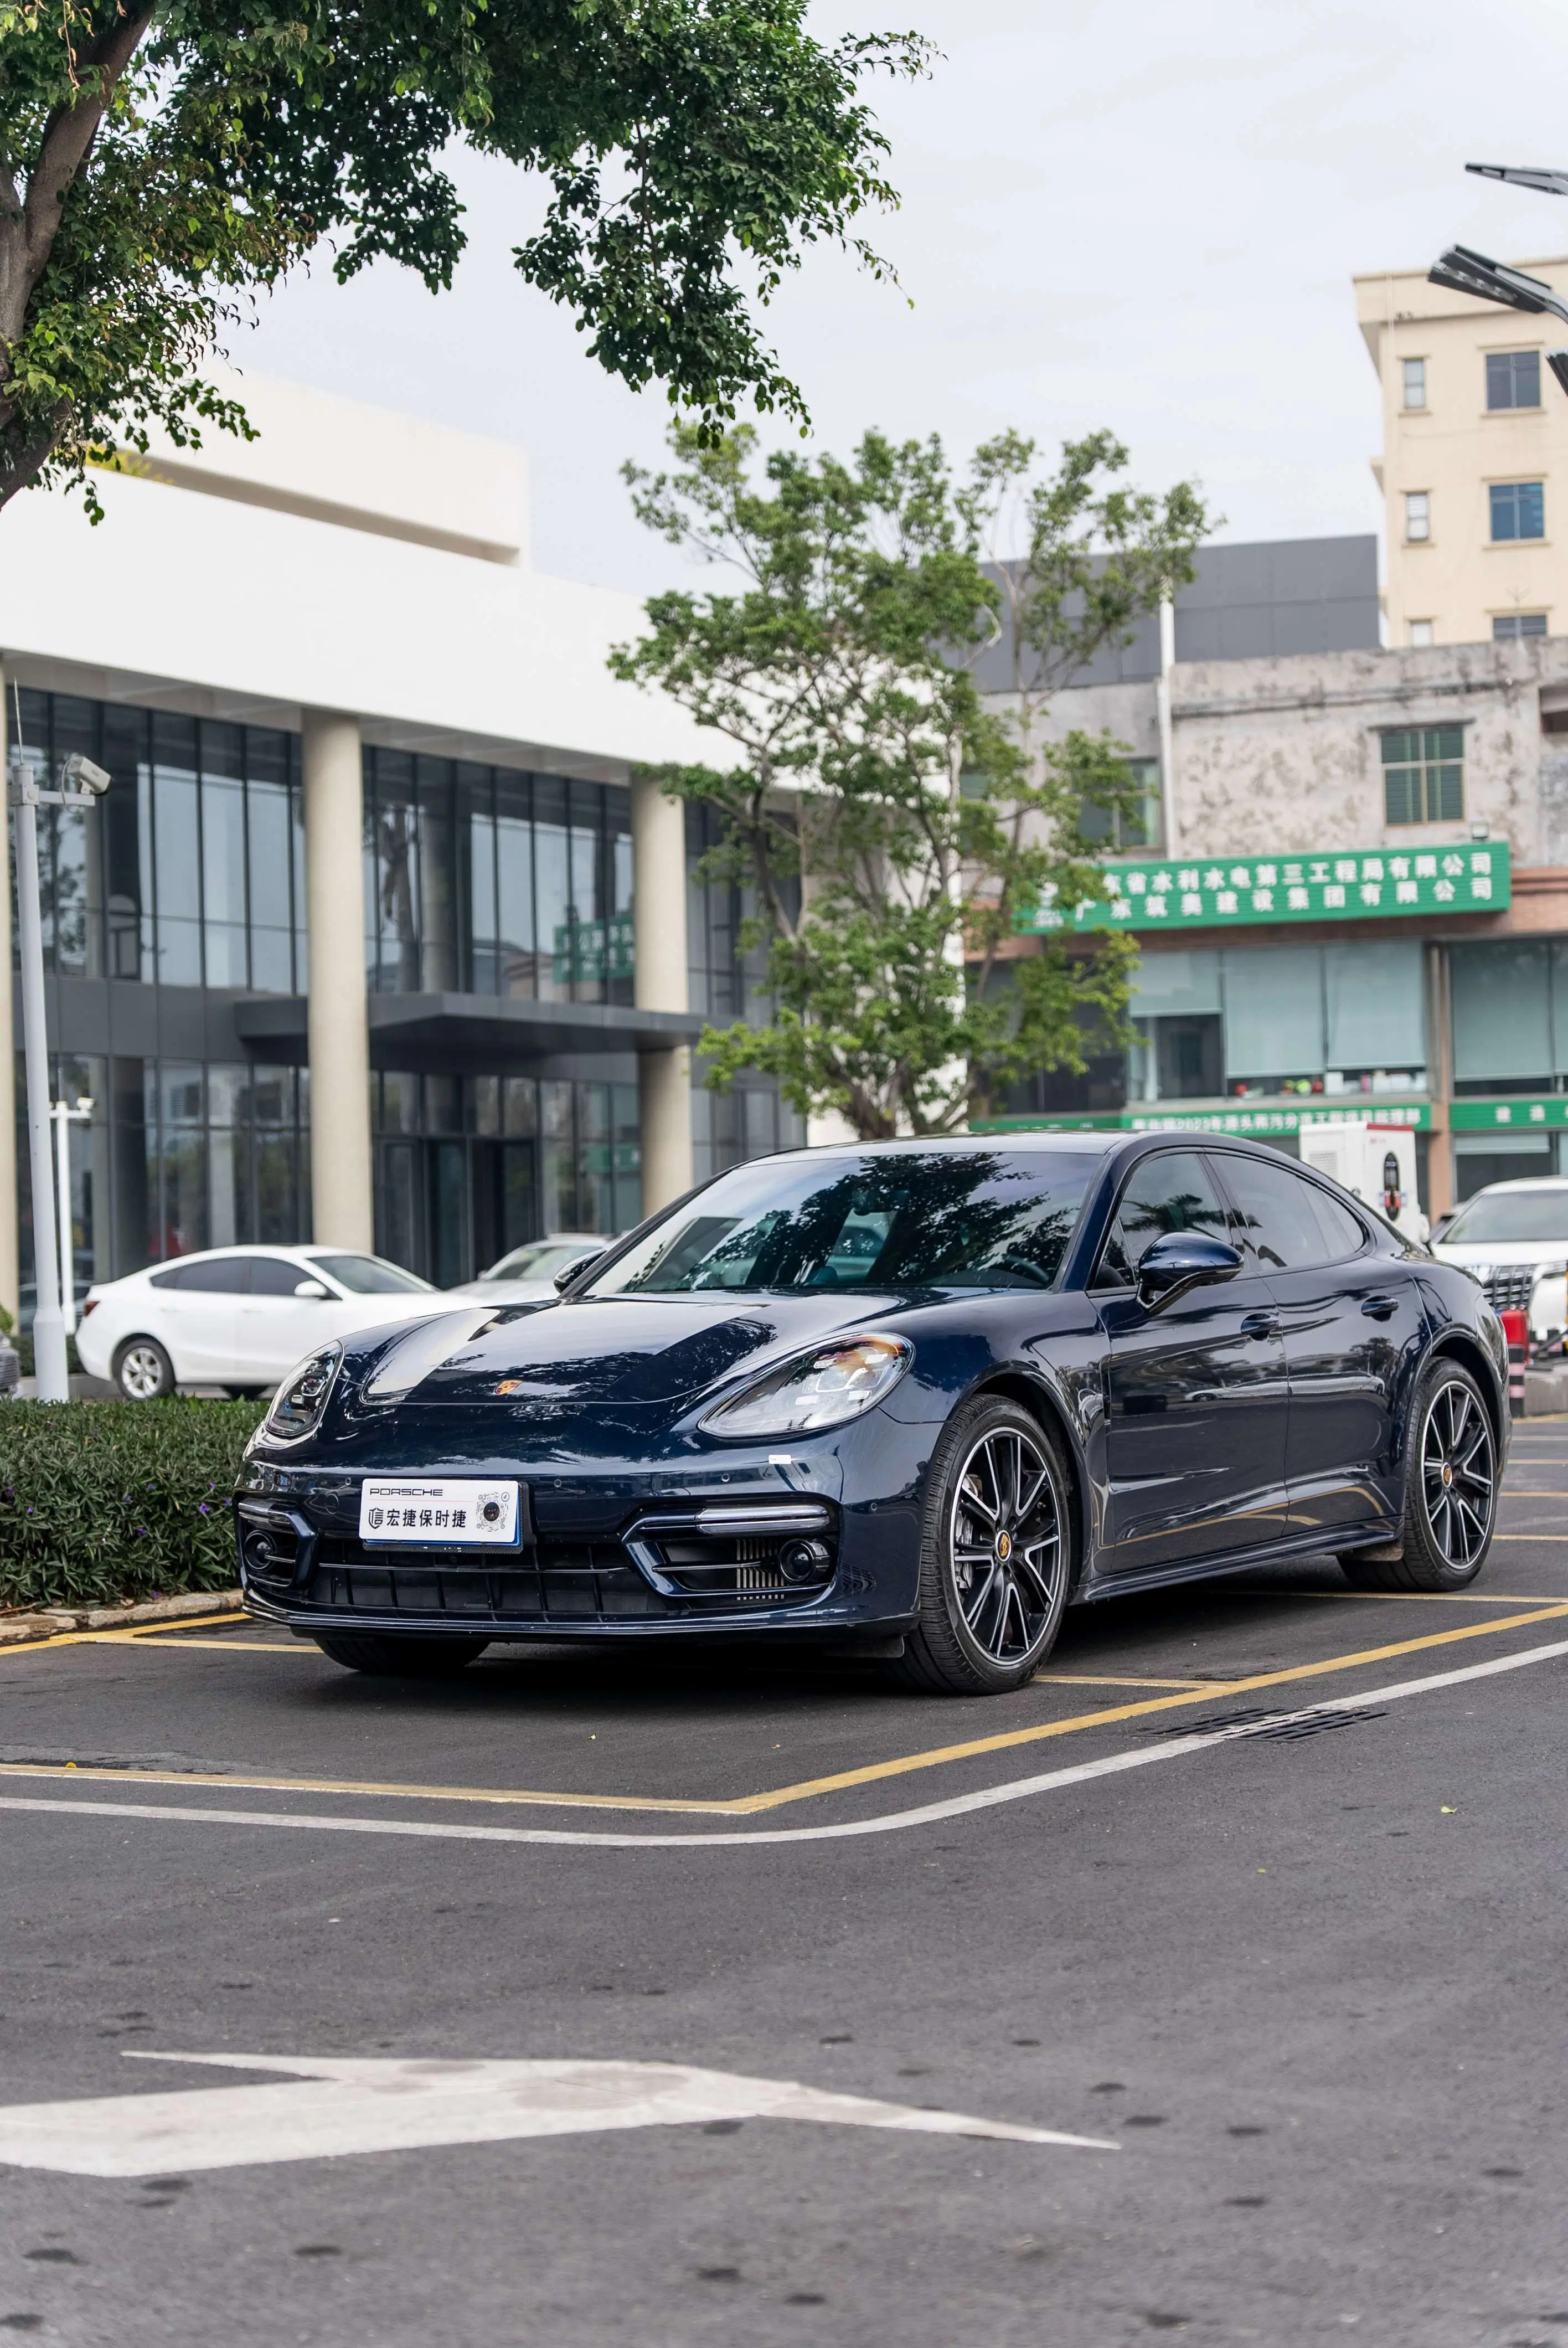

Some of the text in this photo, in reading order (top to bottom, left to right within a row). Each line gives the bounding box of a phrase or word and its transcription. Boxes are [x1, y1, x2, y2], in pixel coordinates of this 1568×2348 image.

[370, 1488, 443, 1496] PORSCHE
[386, 1508, 467, 1528] 宏捷保时捷
